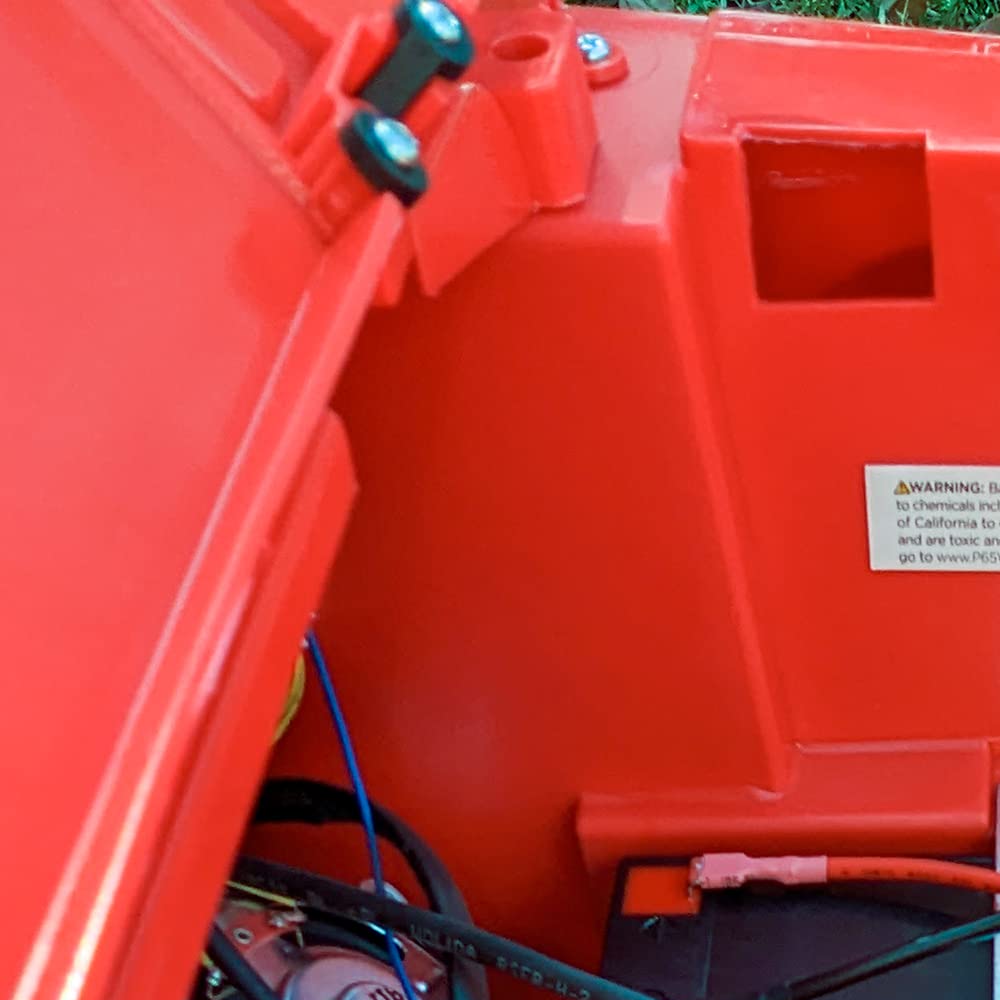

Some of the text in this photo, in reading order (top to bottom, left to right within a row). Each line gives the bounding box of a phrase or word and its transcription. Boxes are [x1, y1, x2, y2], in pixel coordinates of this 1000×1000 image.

[908, 482, 985, 495] WARNING:
[896, 501, 910, 512] to
[913, 500, 975, 512] chemicals
[897, 516, 912, 529] of
[914, 516, 978, 529] California
[981, 518, 996, 530] to
[897, 534, 922, 546] and
[925, 536, 947, 546] are
[949, 534, 980, 547] toxic
[898, 554, 915, 566] go
[917, 552, 934, 564] to
